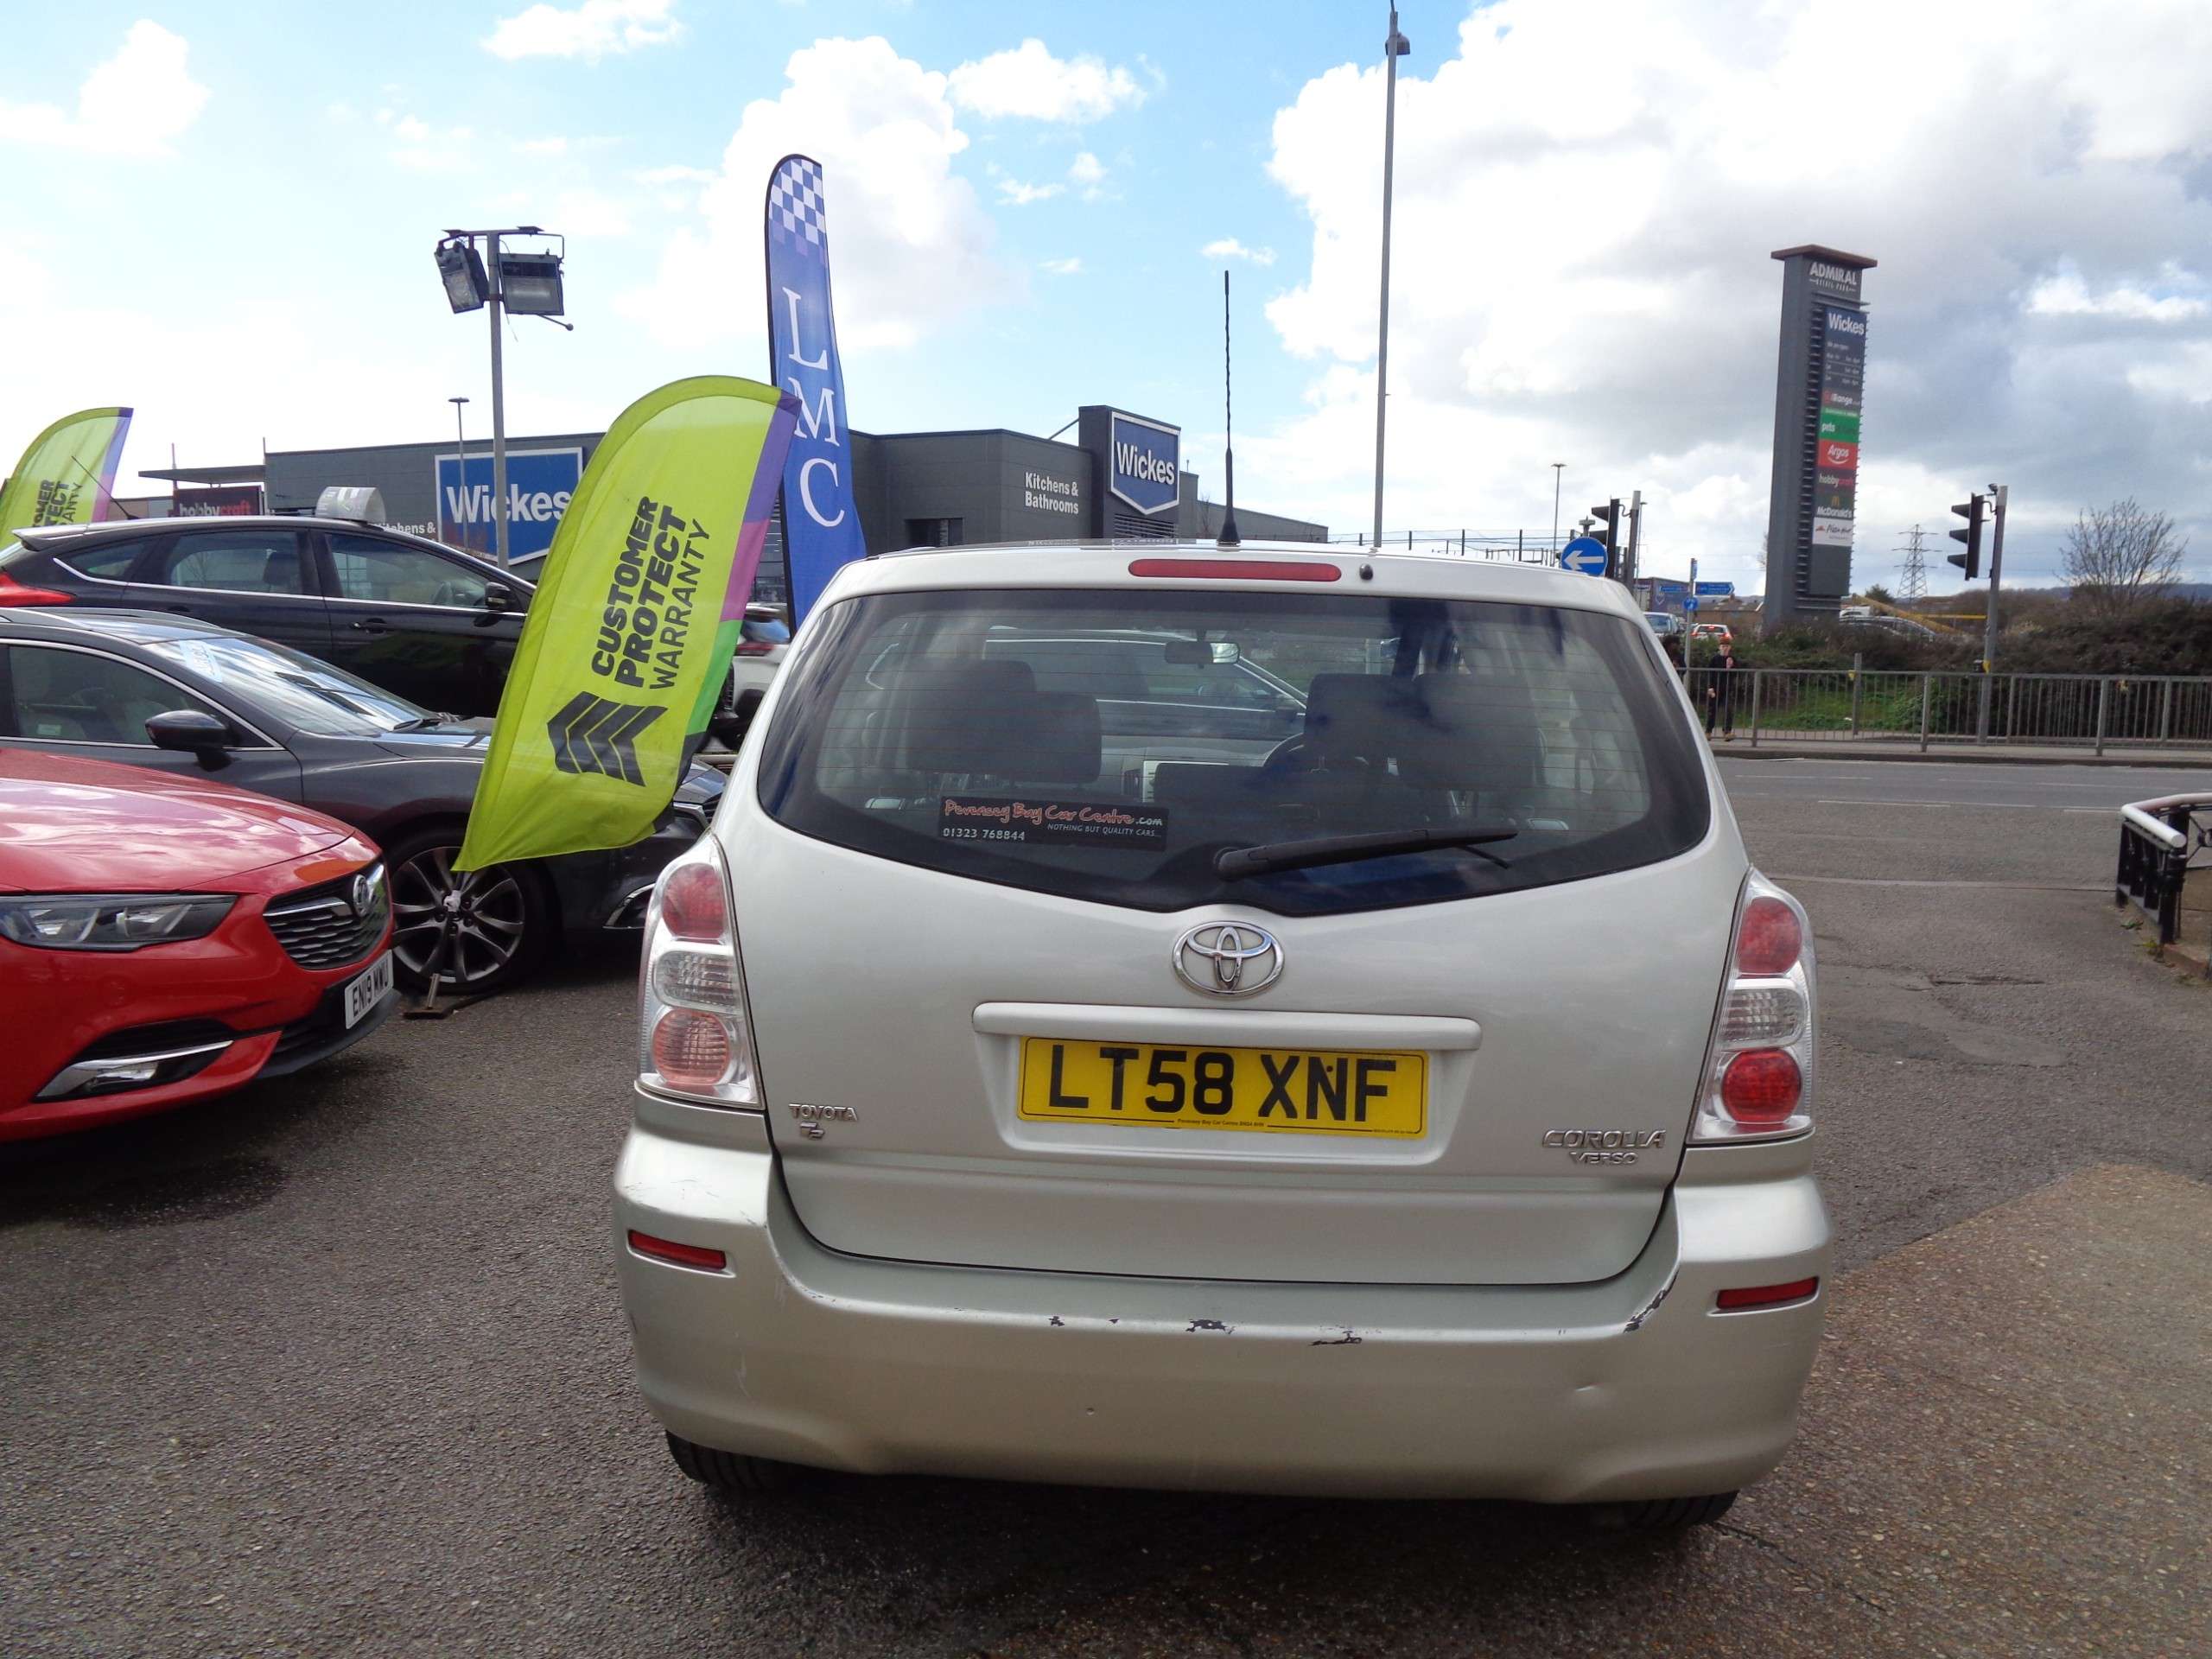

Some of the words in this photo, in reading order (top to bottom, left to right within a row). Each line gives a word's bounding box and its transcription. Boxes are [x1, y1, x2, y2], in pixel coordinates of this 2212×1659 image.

[1809, 262, 1857, 285] ADMIRAL
[1828, 312, 1865, 336] Wickes
[1116, 441, 1176, 485] Wickes
[1827, 444, 1850, 461] Argos
[1025, 472, 1070, 495] Kitchens
[1071, 481, 1078, 497] &
[179, 500, 251, 516] hobbycraft
[1025, 491, 1078, 515] Bathrooms
[1817, 506, 1853, 518] McDonald's
[427, 521, 436, 533] &
[591, 496, 658, 677] CUSTOMER
[614, 505, 687, 688] PROTECT
[649, 518, 710, 690] WARRANTY
[944, 798, 1010, 823] Pevensey
[1012, 802, 1042, 825] Bay
[1045, 804, 1077, 821] Car
[943, 828, 978, 838] 01323
[982, 829, 1026, 841] 768844
[1047, 823, 1083, 832] NOTHING
[1103, 827, 1134, 836] QUALITY
[1048, 1044, 1235, 1116] LT58
[1257, 1053, 1397, 1122] XNF
[788, 1103, 858, 1122] TOYOTA
[1542, 1129, 1667, 1148] COROLLA
[1569, 1151, 1638, 1166] VERSO
